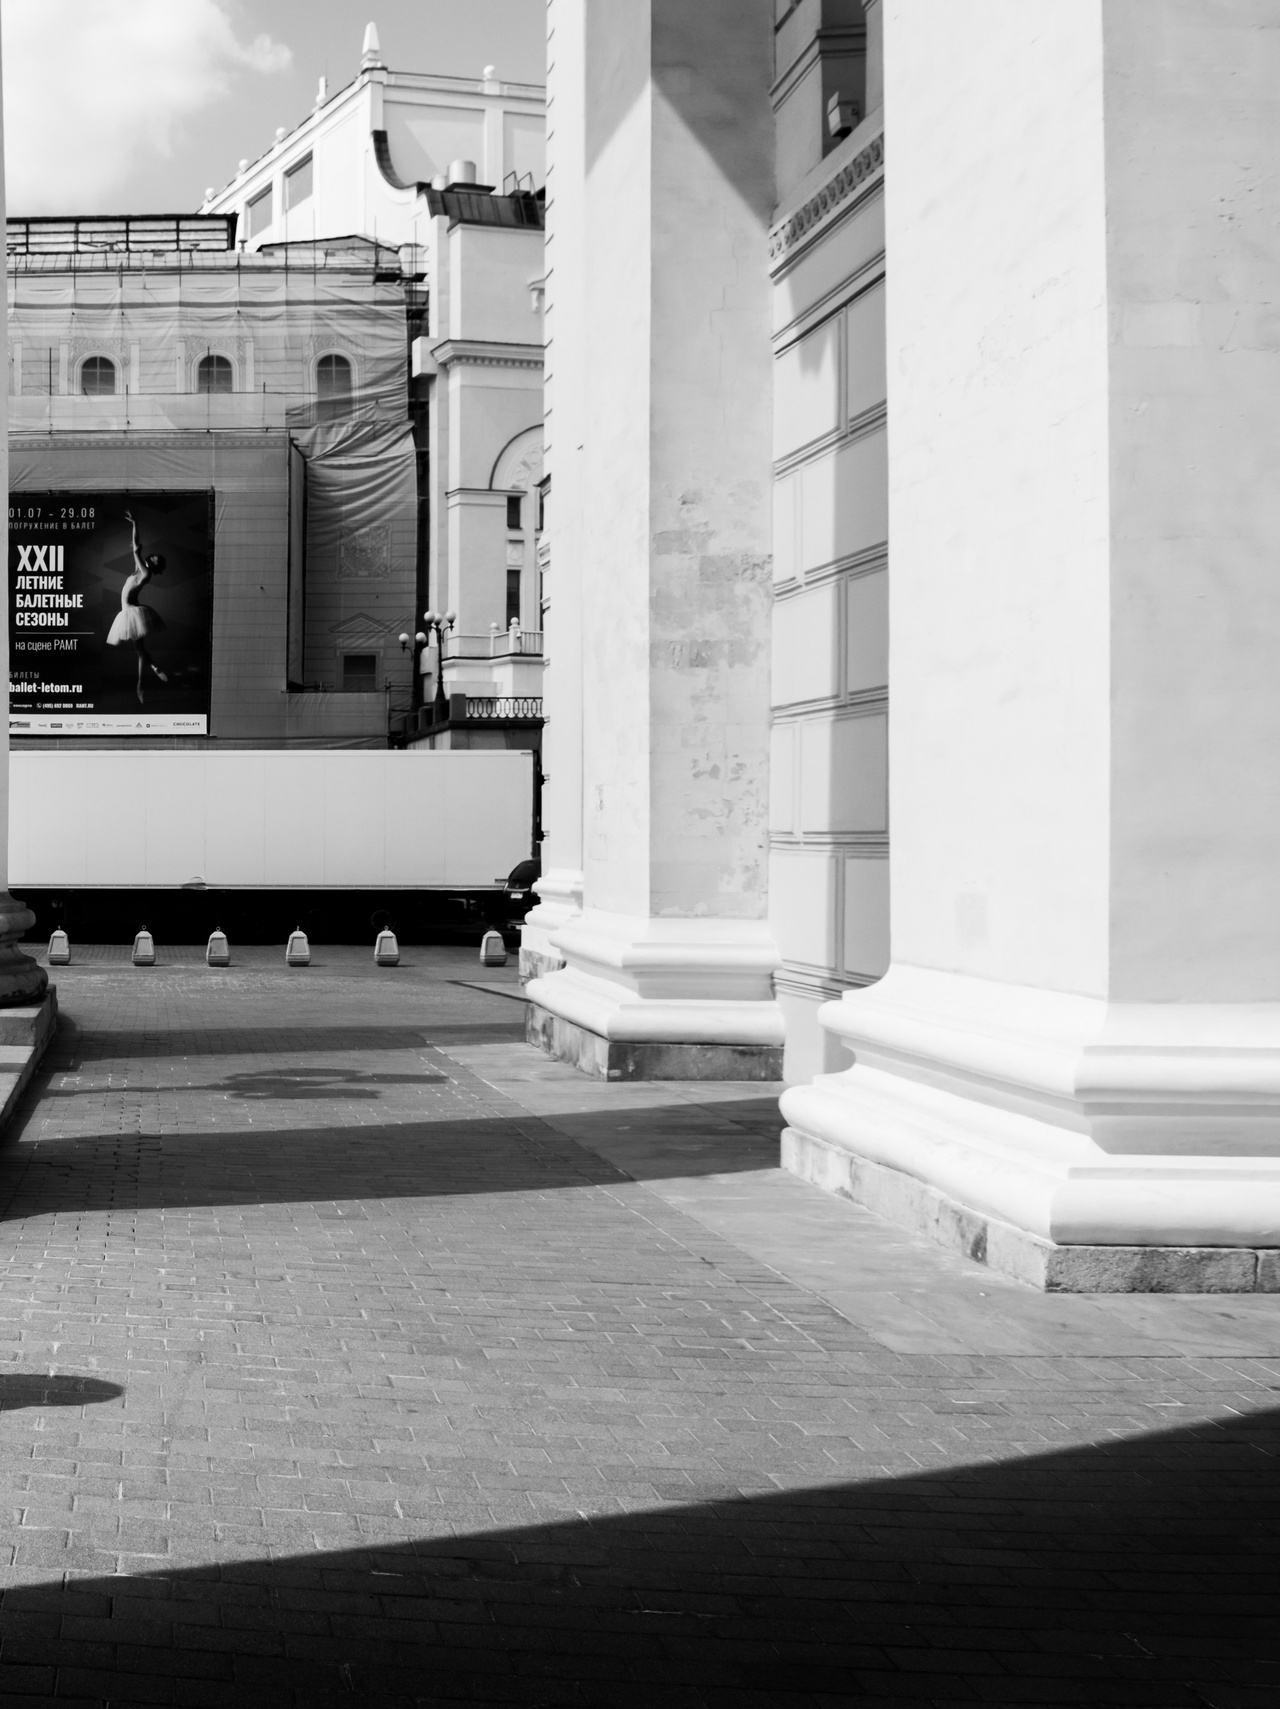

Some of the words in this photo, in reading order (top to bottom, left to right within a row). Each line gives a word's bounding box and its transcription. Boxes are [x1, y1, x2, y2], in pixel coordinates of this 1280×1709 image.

[9, 507, 41, 518] 01.07
[60, 507, 95, 518] 29.08
[9, 522, 59, 530] ПОГРУЖЕНИЕ
[17, 545, 64, 571] XXII
[15, 576, 64, 589] ЛЕТНИЕ
[16, 594, 83, 608] БАЛЕТНЫЕ
[15, 612, 69, 626] СЕЗОНЫ
[15, 641, 25, 650] на
[27, 641, 52, 651] сцене
[53, 639, 78, 650] РАМТ
[9, 671, 40, 679] БИЛЕТЫ
[9, 682, 83, 693] ballet-letom.ru
